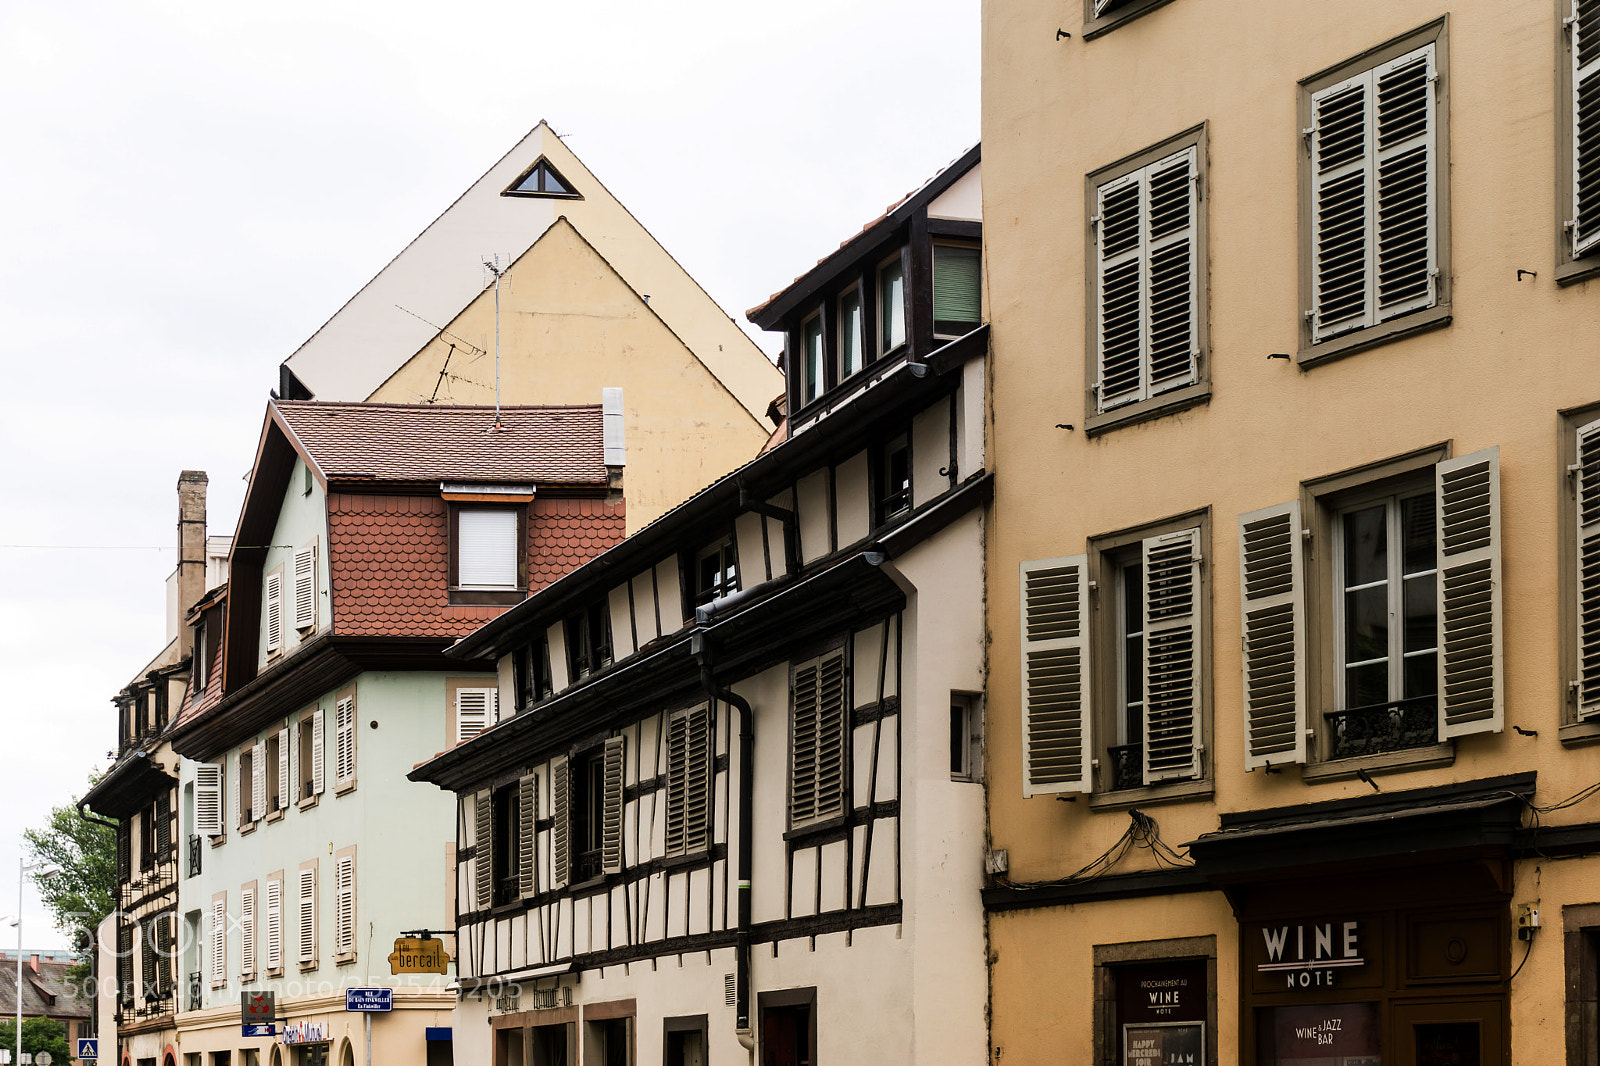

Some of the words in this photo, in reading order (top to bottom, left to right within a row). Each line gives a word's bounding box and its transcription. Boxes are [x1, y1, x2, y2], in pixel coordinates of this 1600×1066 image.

[1262, 921, 1358, 962] WINE
[399, 944, 441, 968] bercail
[1180, 978, 1188, 987] AU
[1287, 970, 1333, 988] NOTE
[1149, 991, 1179, 1004] WINE
[1295, 1027, 1317, 1039] WINE
[1322, 1018, 1342, 1031] JAZZ
[1132, 1039, 1155, 1049] HAPPY
[1317, 1033, 1333, 1045] BAR
[1170, 1053, 1194, 1064] JAM
